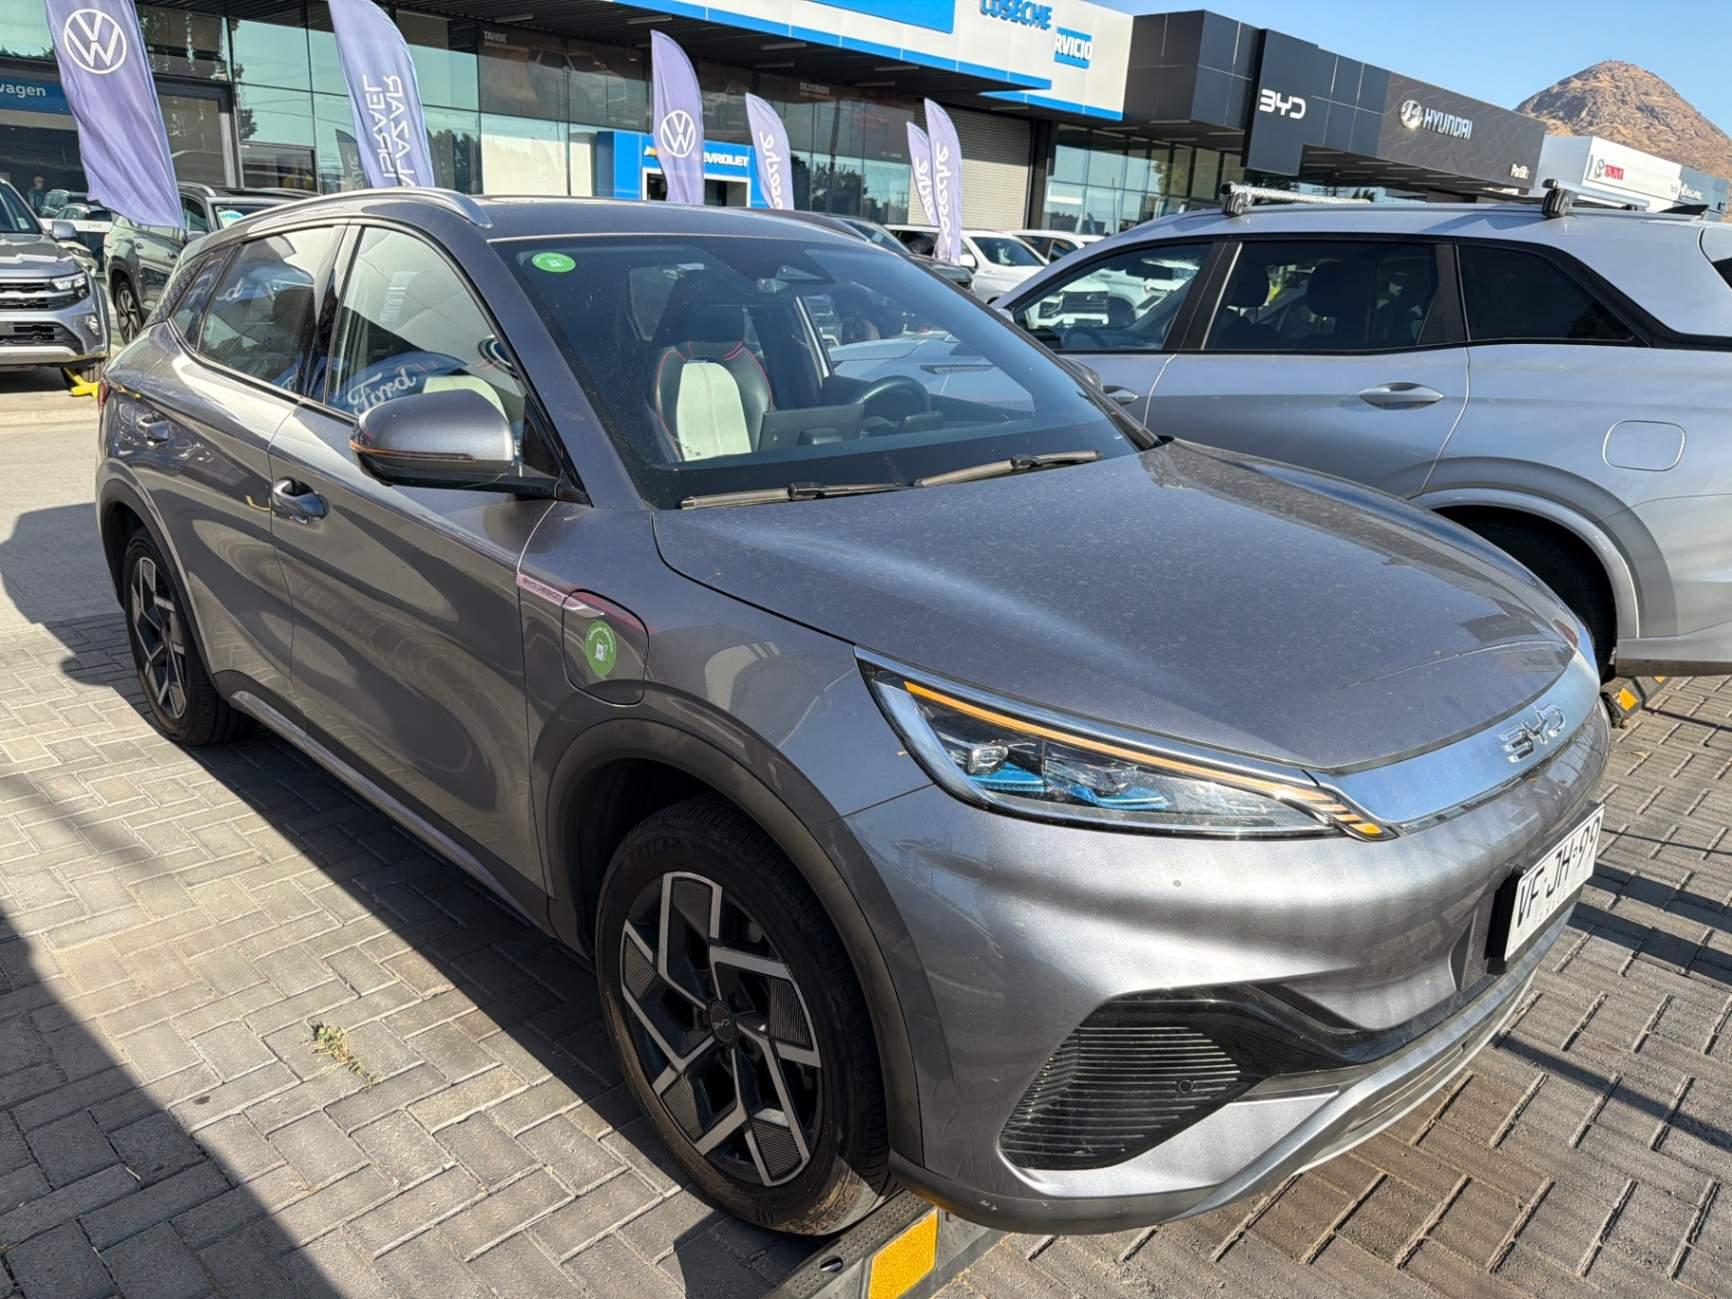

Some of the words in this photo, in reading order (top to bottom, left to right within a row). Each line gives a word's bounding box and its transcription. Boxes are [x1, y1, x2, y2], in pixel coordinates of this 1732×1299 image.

[1259, 88, 1306, 120] BYD
[1423, 107, 1473, 140] HYUNDAI
[1500, 703, 1566, 763] BYD
